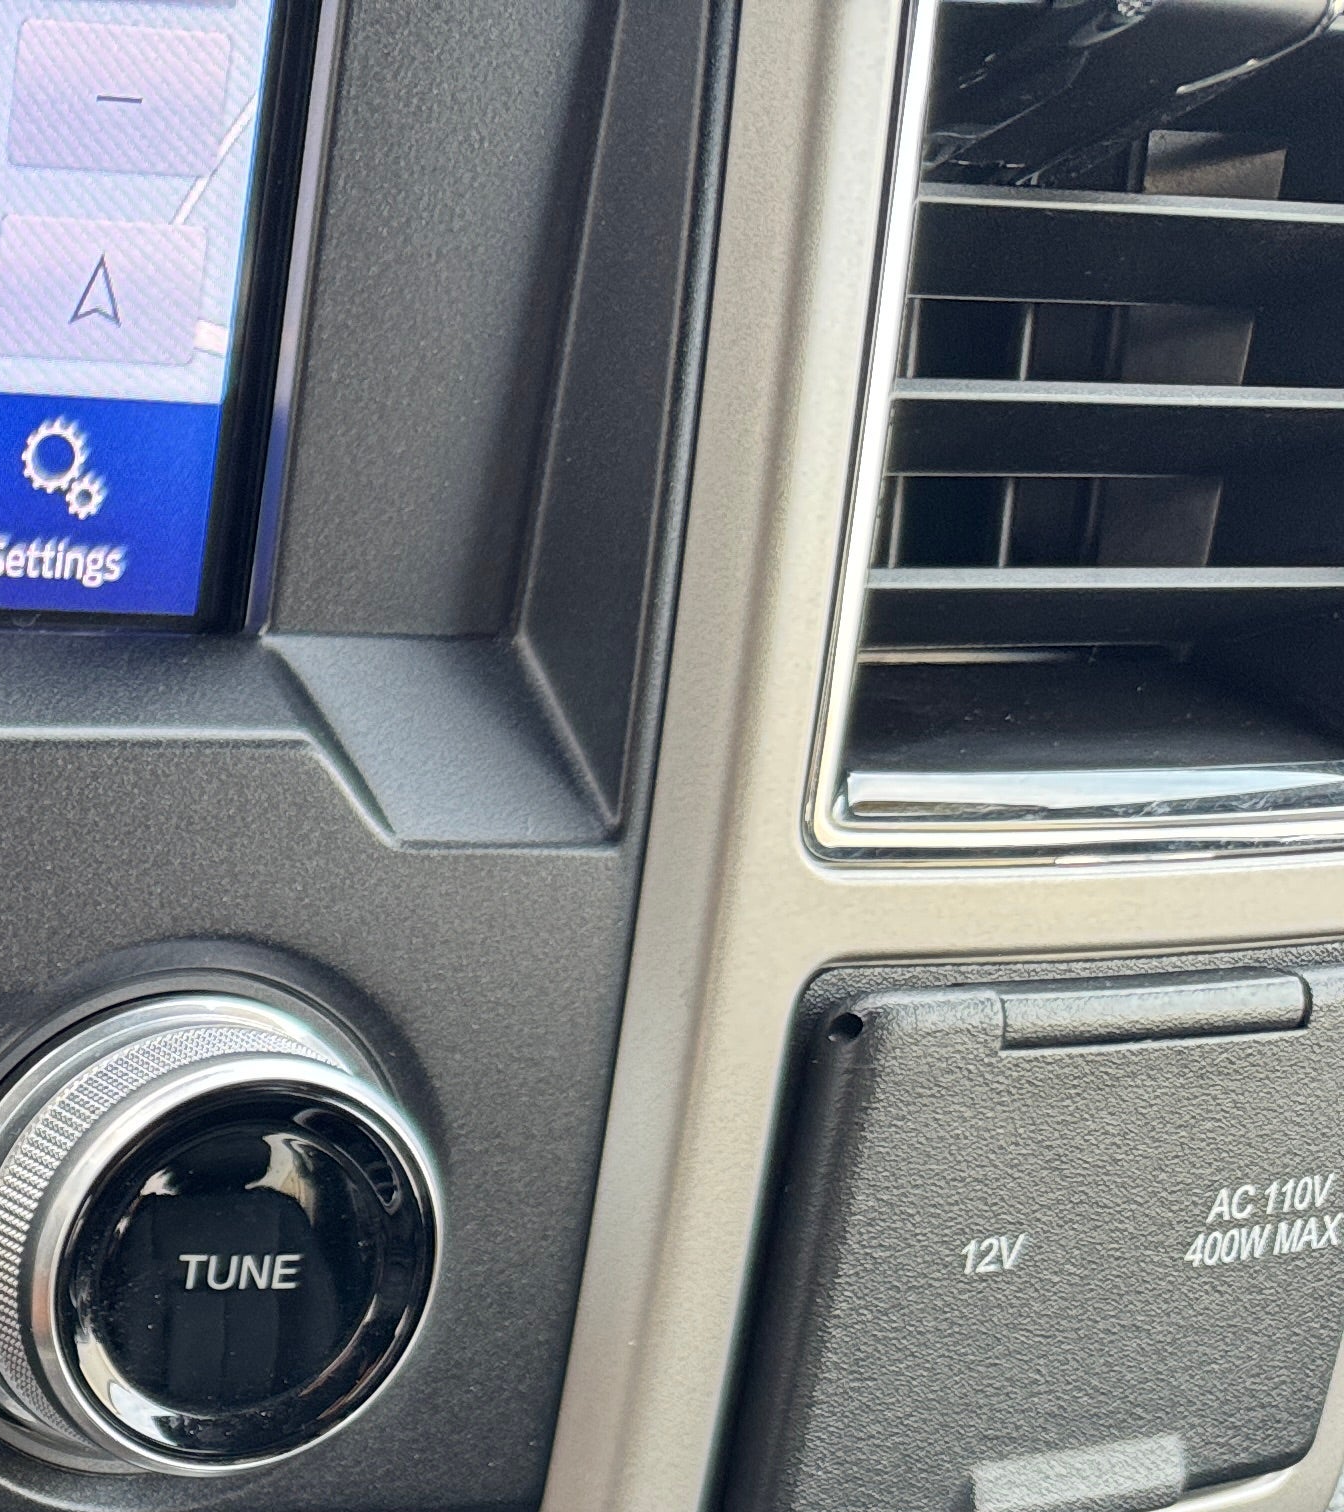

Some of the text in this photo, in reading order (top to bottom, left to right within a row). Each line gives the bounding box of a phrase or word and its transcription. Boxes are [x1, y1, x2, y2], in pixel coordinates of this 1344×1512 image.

[1205, 1171, 1336, 1224] AC 110V
[960, 1233, 1028, 1276] 12V
[1183, 1211, 1344, 1268] 400W MAX
[178, 1254, 304, 1291] TUNE
